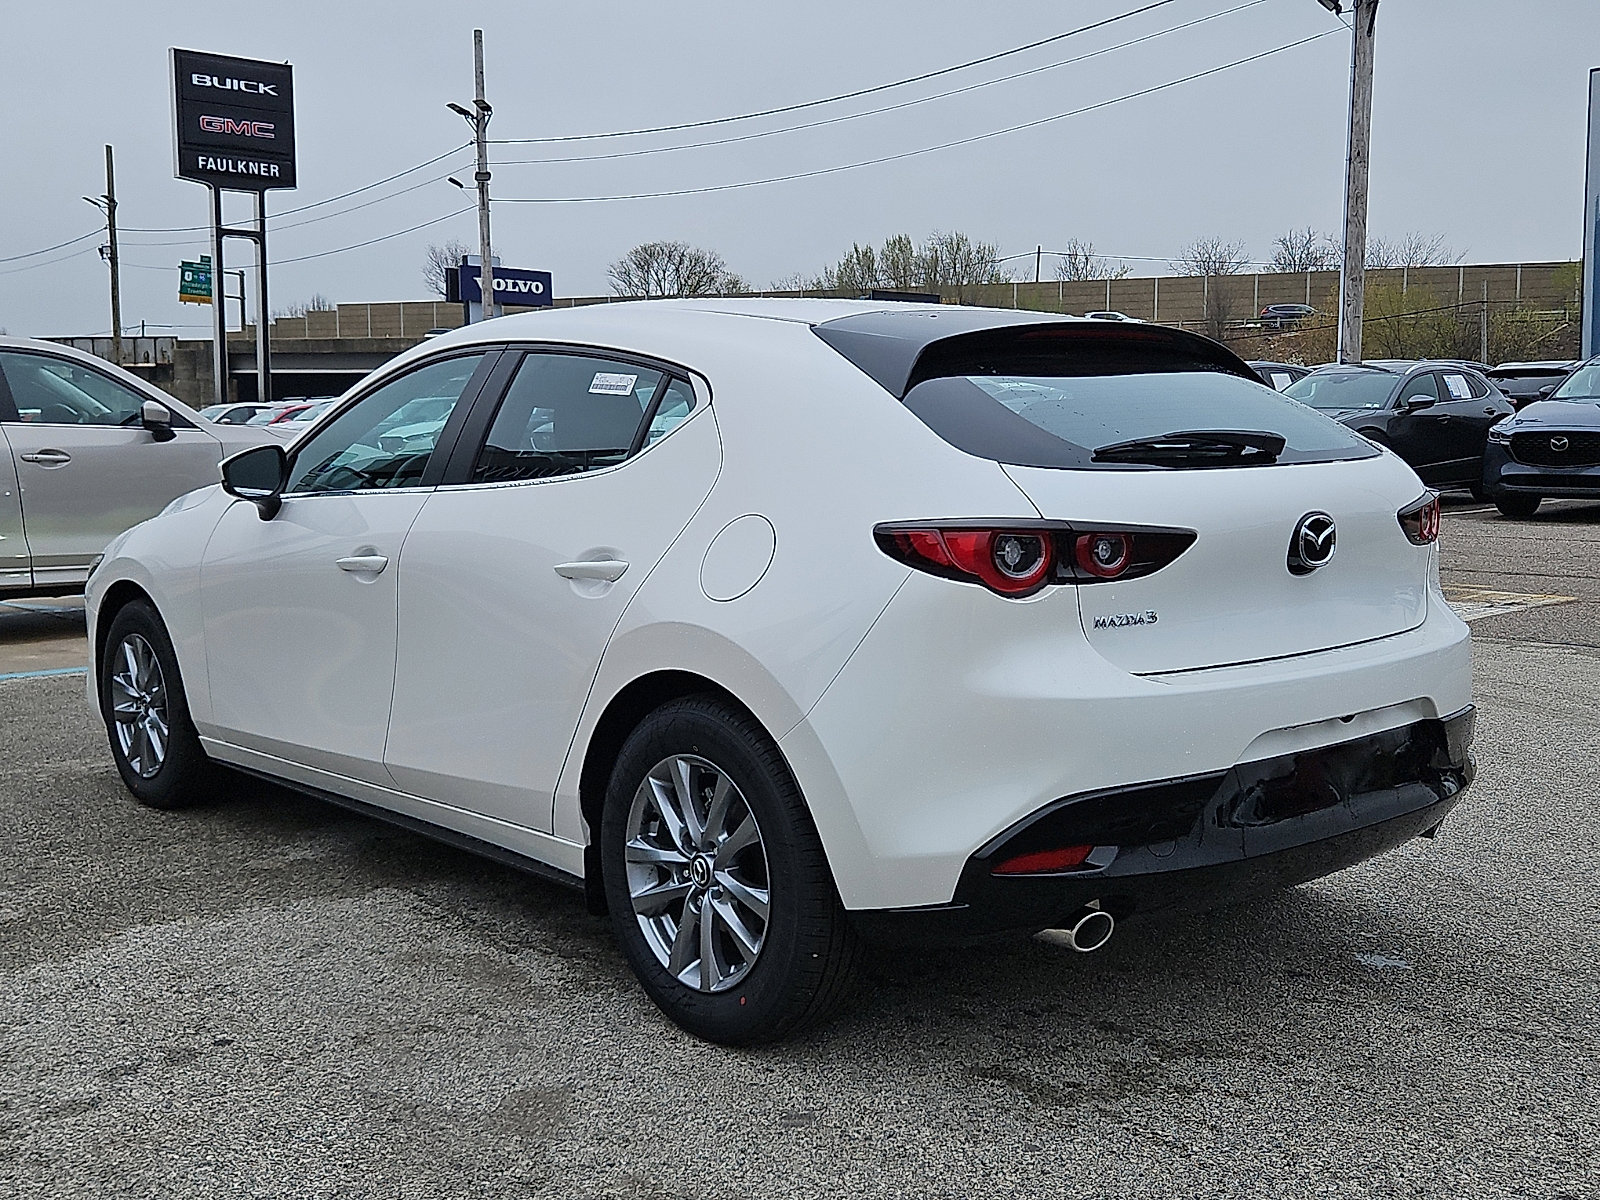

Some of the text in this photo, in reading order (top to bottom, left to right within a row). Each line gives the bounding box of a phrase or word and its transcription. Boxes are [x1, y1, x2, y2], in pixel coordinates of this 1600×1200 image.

[191, 73, 279, 96] BUICK
[199, 115, 275, 138] GMC
[198, 156, 280, 177] FAULKNER
